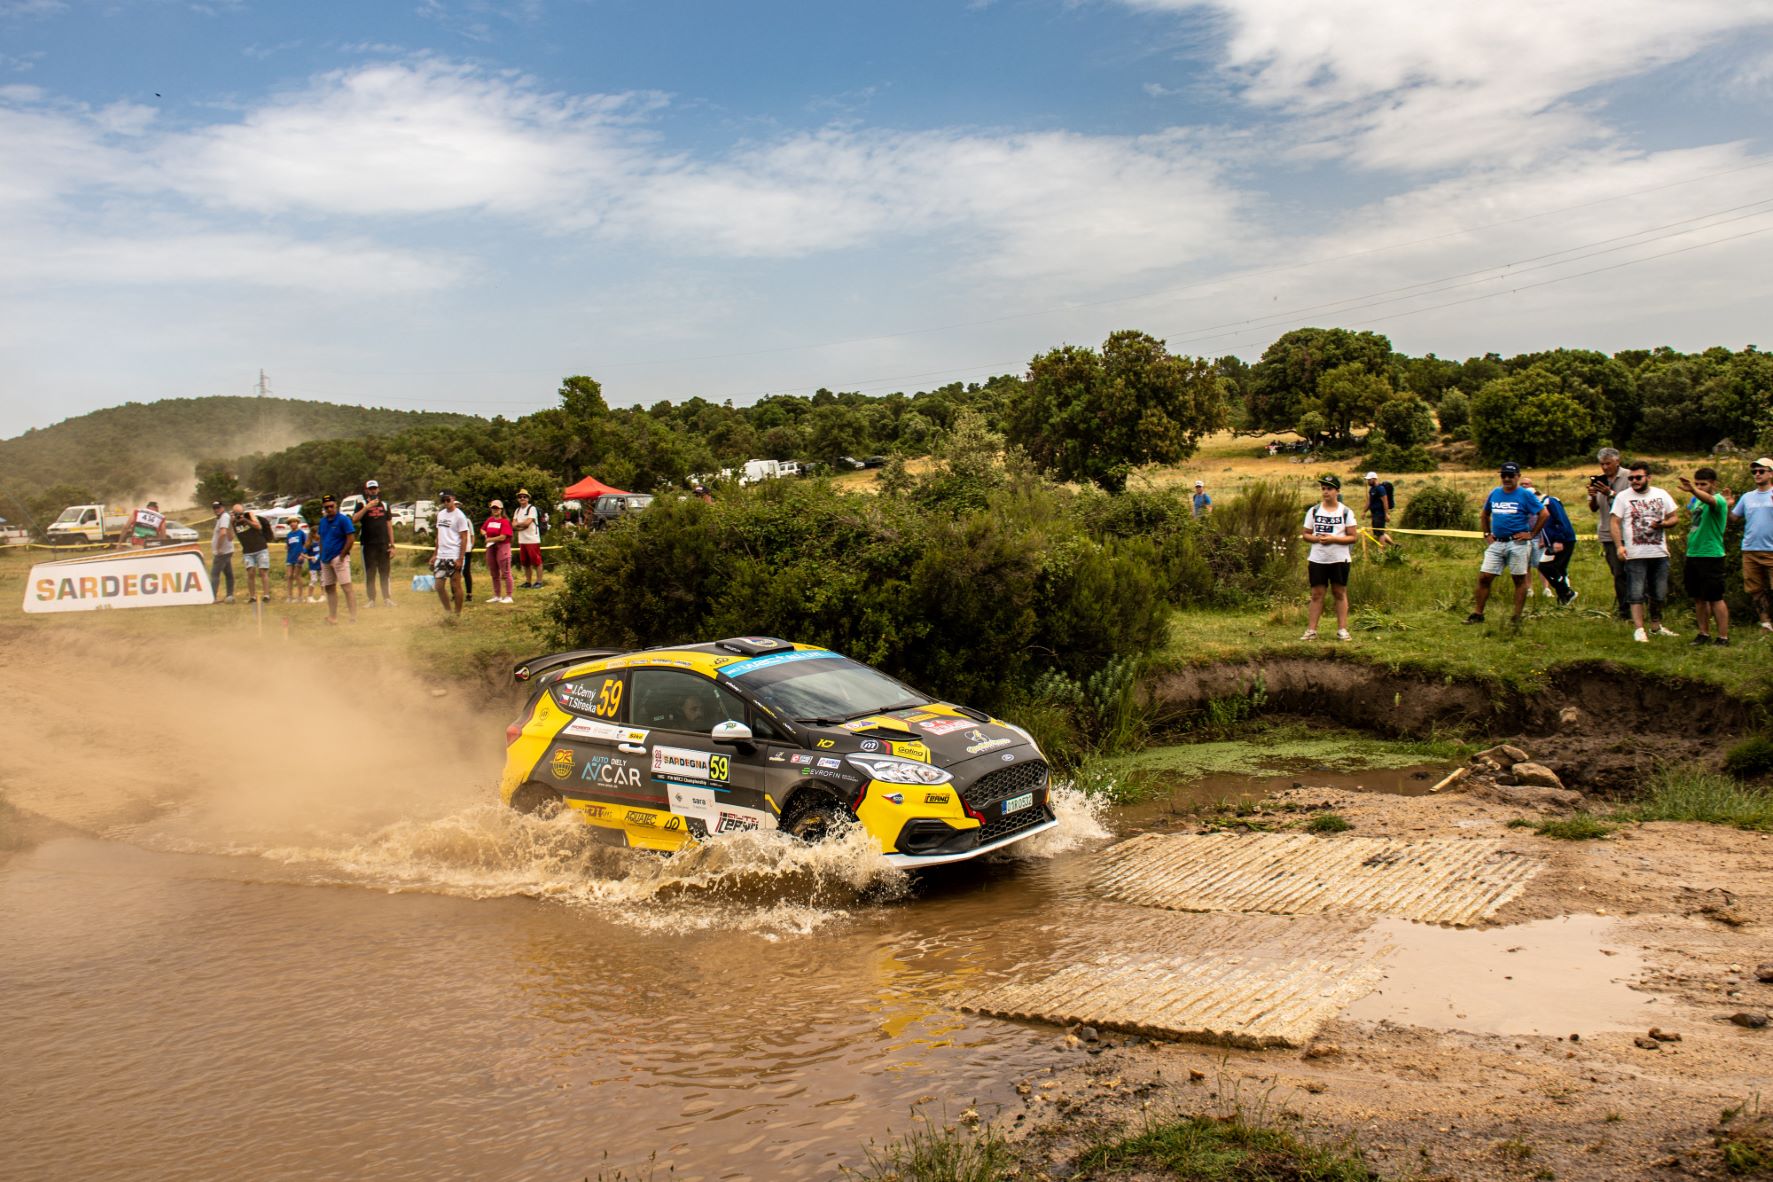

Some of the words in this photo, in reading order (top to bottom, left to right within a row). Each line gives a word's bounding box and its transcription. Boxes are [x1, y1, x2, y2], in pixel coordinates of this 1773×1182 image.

[36, 571, 203, 602] SARDEGNA
[572, 683, 597, 701] J.Černý
[597, 679, 623, 718] 59
[592, 755, 609, 764] AUTO
[663, 755, 708, 770] SARDEGNA
[710, 755, 728, 780] 59
[692, 797, 706, 805] sara
